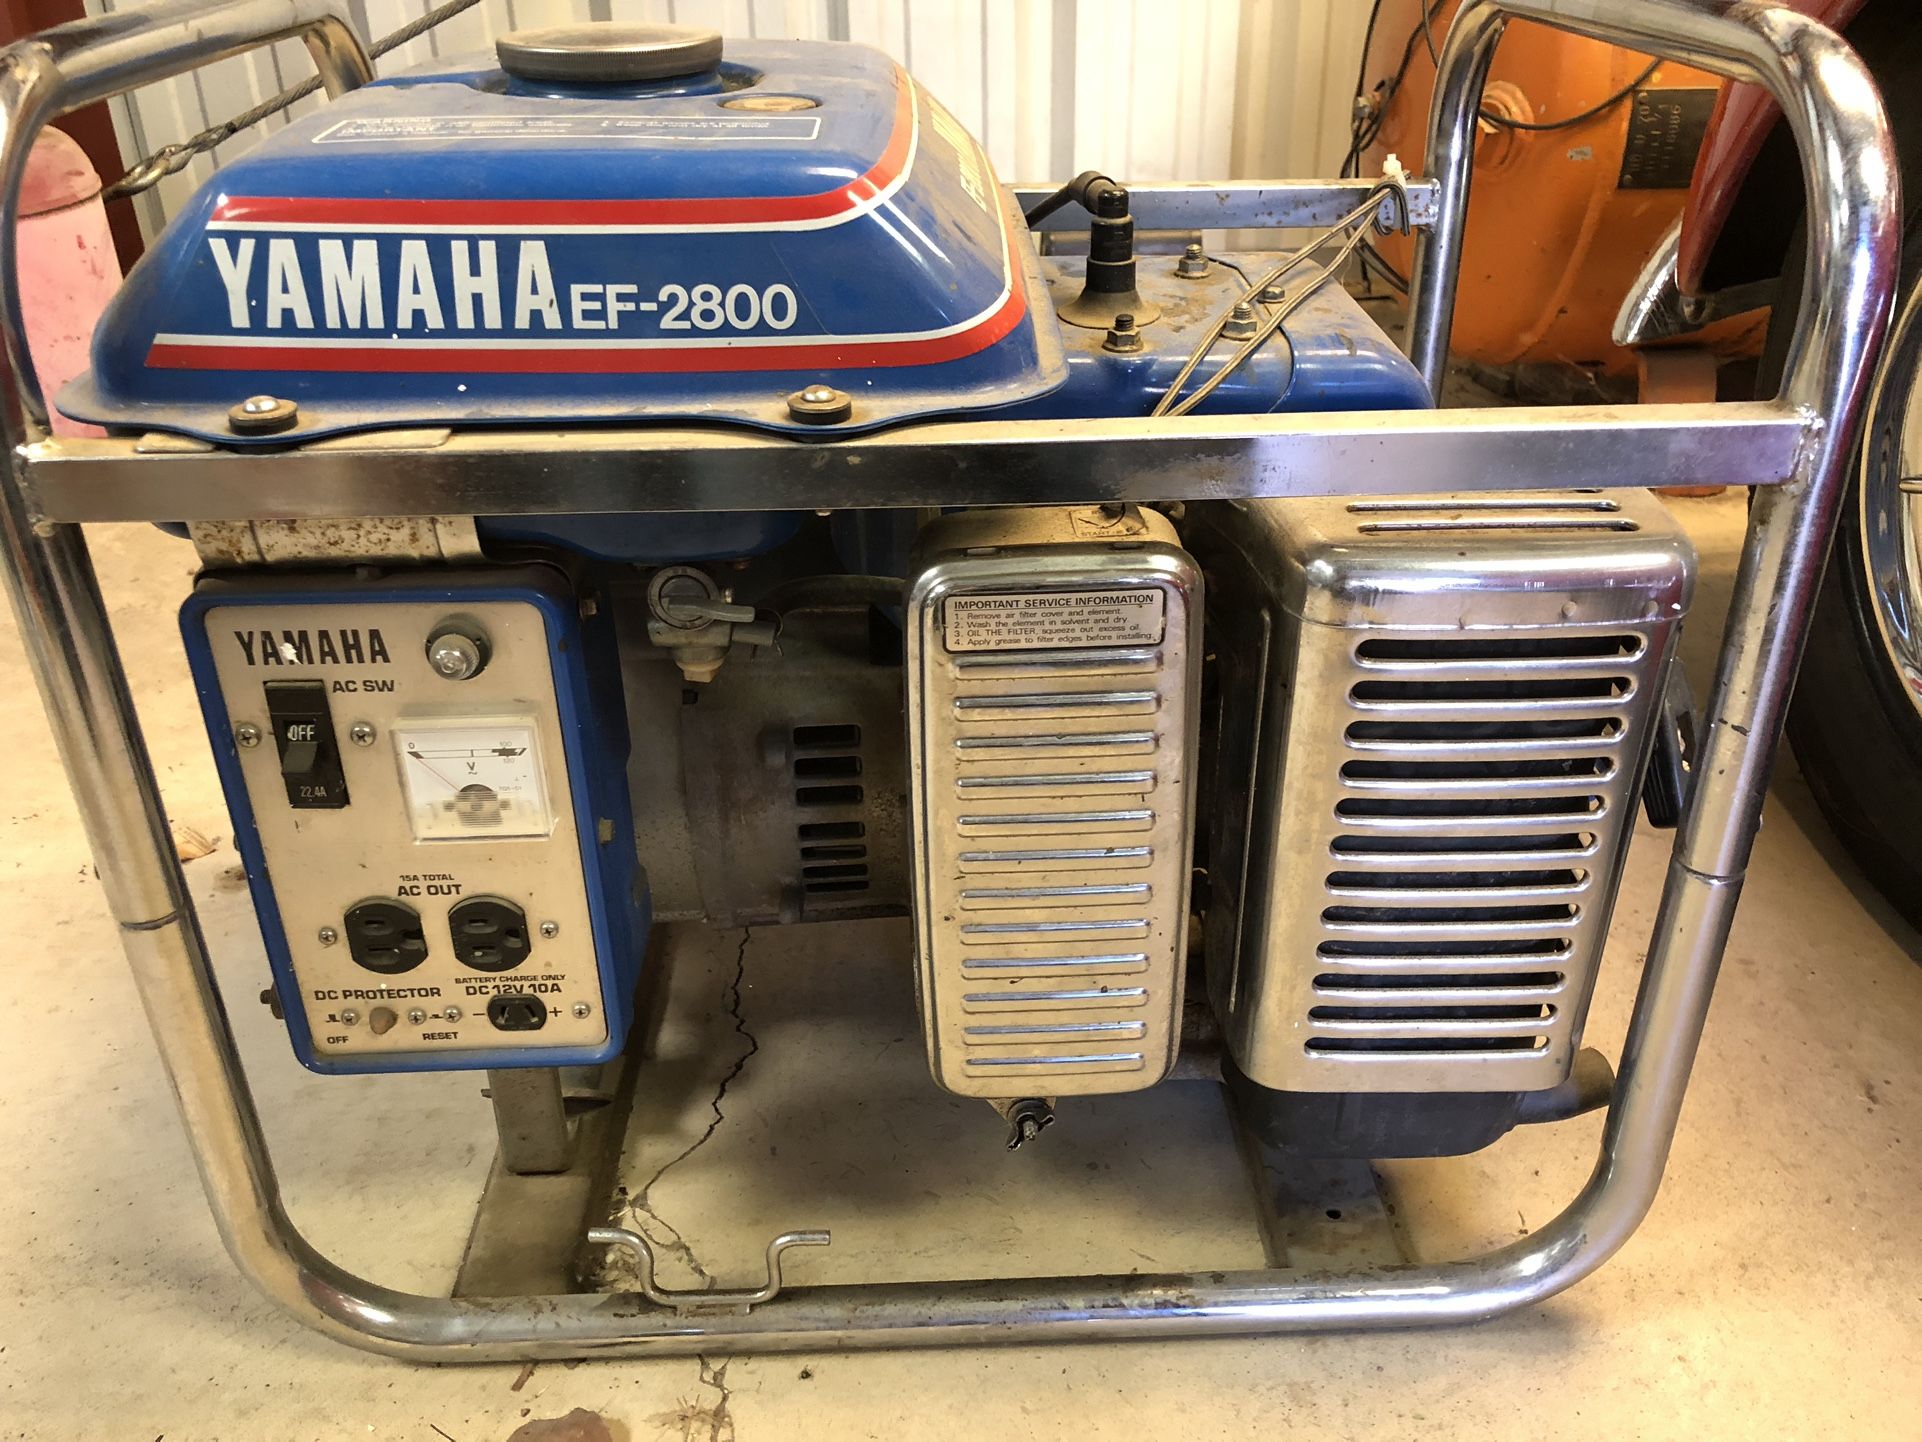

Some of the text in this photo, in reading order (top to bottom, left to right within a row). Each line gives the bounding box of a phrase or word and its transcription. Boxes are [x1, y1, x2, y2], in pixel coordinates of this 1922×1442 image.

[208, 238, 798, 331] YAMAHA EF-2800
[954, 594, 1154, 610] IMPORTANT SERVICE INFORMATION
[967, 612, 1001, 620] Remove
[1005, 611, 1016, 619] air
[1019, 611, 1037, 619] filter
[1041, 610, 1064, 618] cover
[1068, 609, 1084, 617] and
[954, 621, 963, 629] 2.
[967, 620, 991, 628] Wash
[995, 619, 1008, 627] the
[1012, 619, 1045, 627] element
[1061, 617, 1090, 625] solvent
[1093, 616, 1109, 624] and
[954, 630, 963, 638] 3.
[967, 629, 982, 637] OIL
[985, 628, 1003, 636] THE
[1042, 627, 1076, 635] squeeze
[234, 628, 391, 666] YAMAHA
[967, 638, 991, 647] Apply
[994, 638, 1022, 646] grease
[1025, 636, 1034, 644] to
[1037, 636, 1055, 644] filter
[1058, 635, 1082, 644] edges
[1086, 634, 1112, 642] before
[332, 680, 395, 694] AC SW
[288, 724, 316, 741] OFF
[467, 761, 476, 771] V
[300, 785, 327, 798] 22.4A
[399, 873, 455, 882] 15A TOTAL
[398, 884, 462, 897] AC OUT
[455, 976, 497, 984] BATTERY
[314, 986, 441, 1001] DC PROTECTOR
[465, 983, 562, 996] DC 12V 10A
[327, 1035, 349, 1045] OFF
[422, 1031, 458, 1041] RESET
